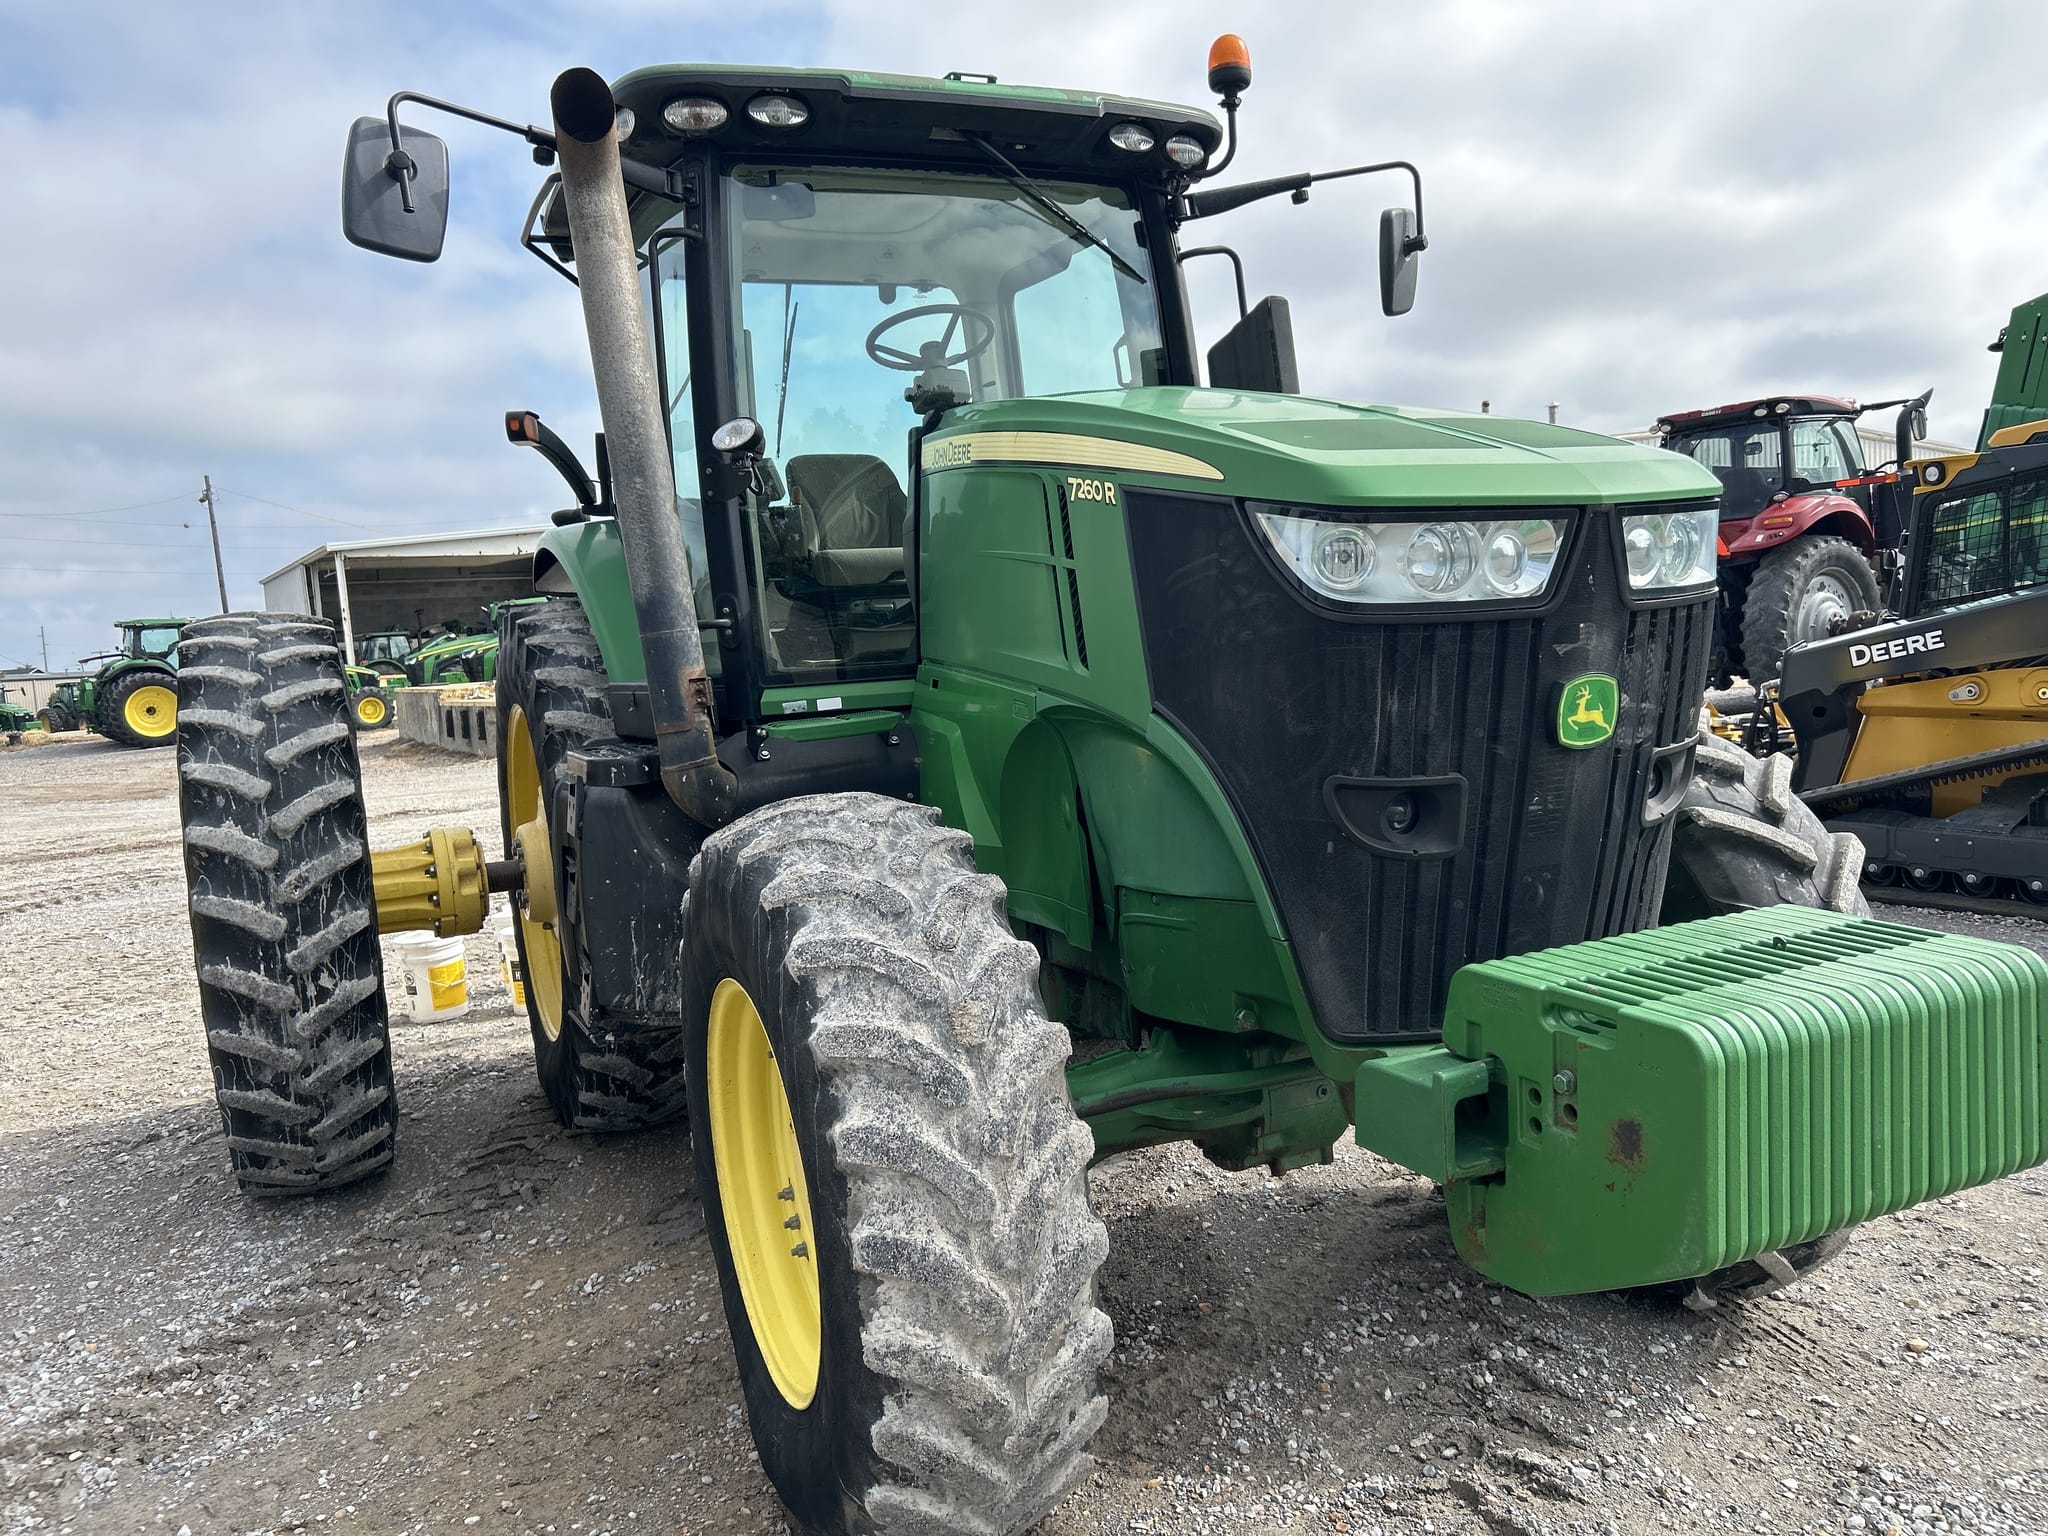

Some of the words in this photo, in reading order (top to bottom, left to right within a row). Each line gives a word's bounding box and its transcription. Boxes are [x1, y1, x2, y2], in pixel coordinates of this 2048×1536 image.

[931, 447, 949, 467] JOHN
[948, 441, 972, 465] DEERE
[1067, 476, 1103, 502] 7260
[1103, 481, 1116, 505] R
[1849, 630, 1945, 667] DEERE
